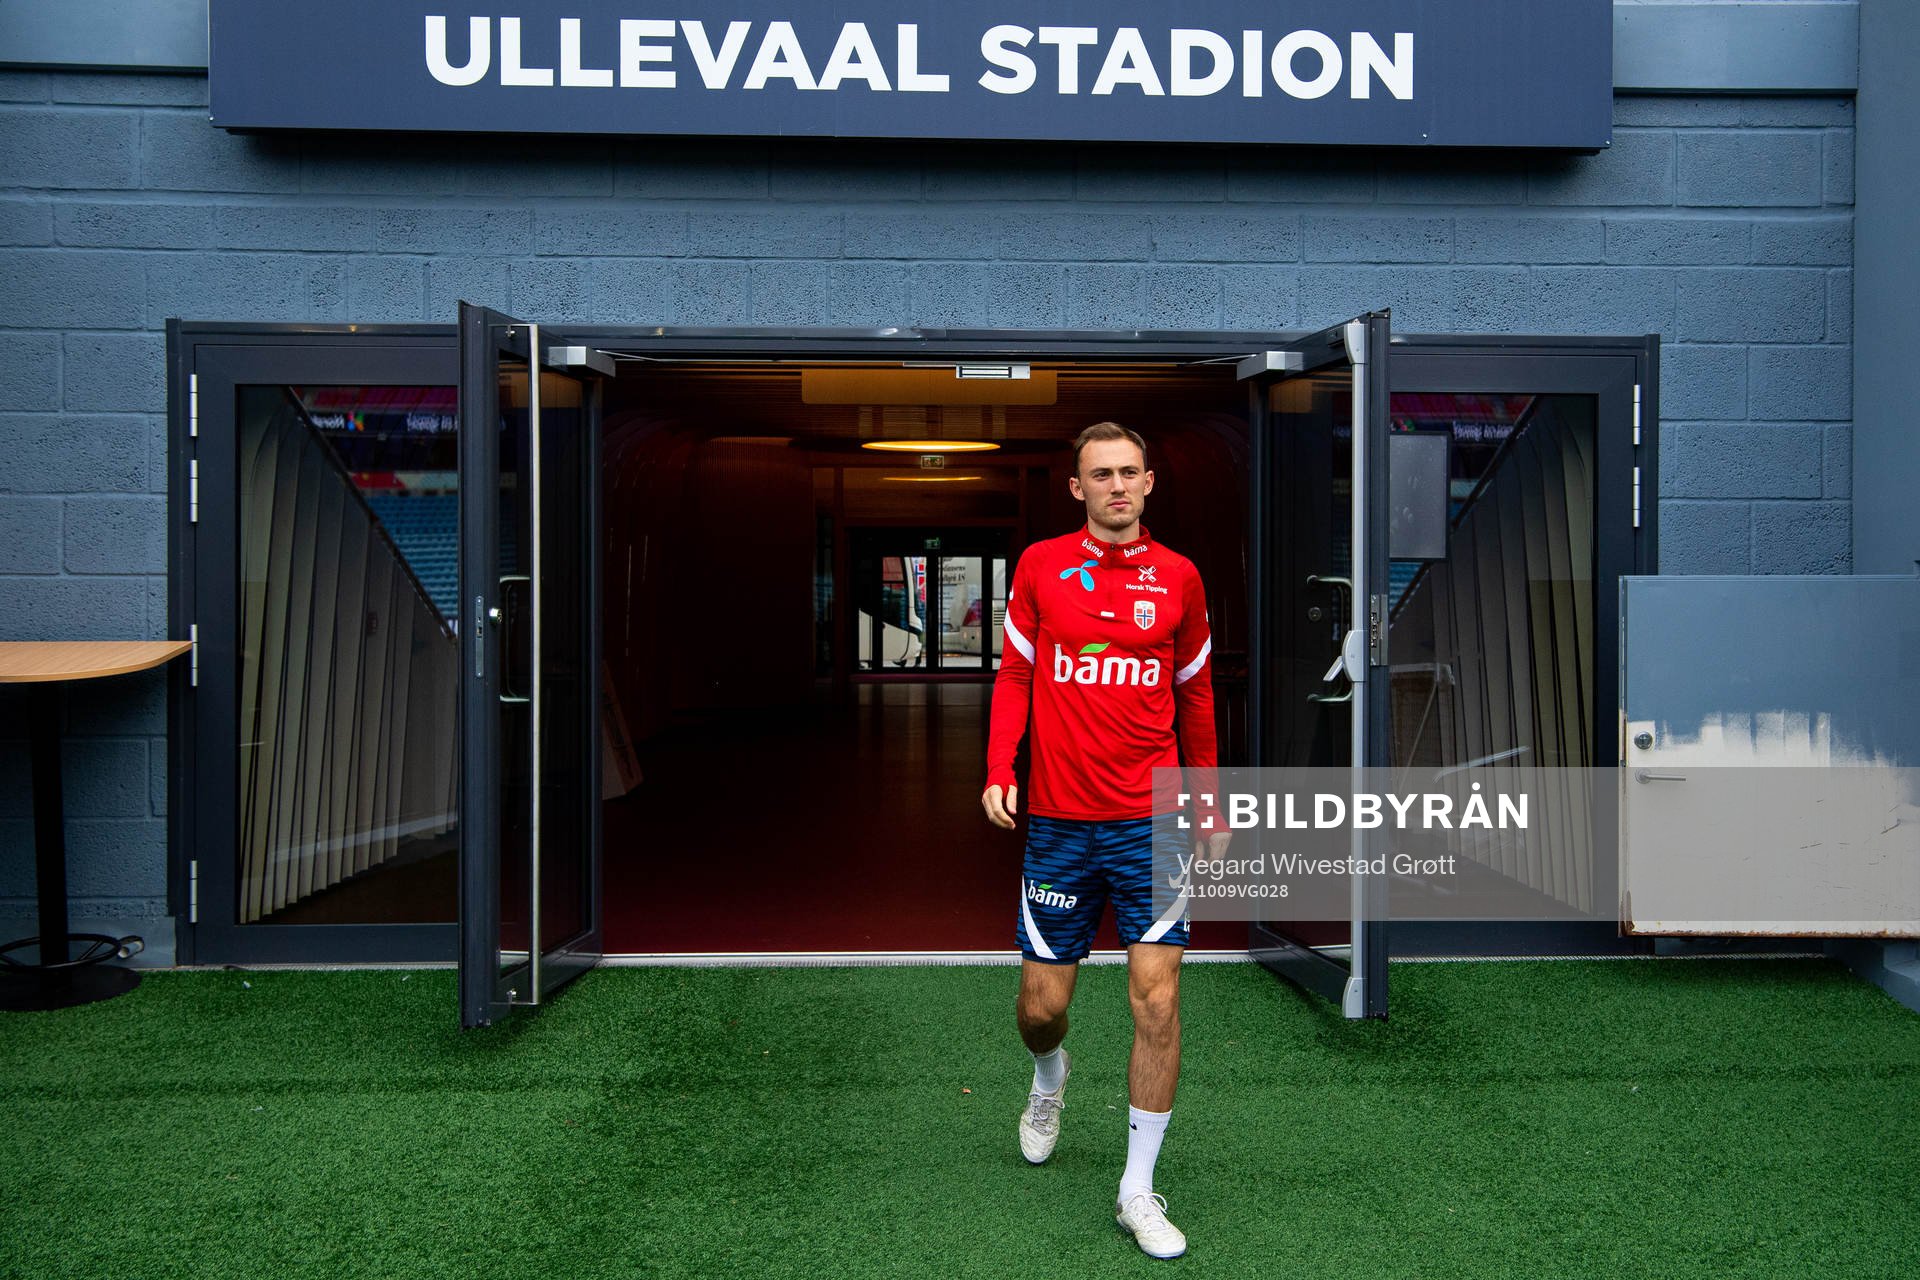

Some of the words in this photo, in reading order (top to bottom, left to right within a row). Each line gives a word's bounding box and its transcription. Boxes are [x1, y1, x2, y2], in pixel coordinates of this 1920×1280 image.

[425, 16, 950, 92] ULLEVAAL
[979, 25, 1414, 99] STADION
[1081, 538, 1105, 558] bama
[1124, 544, 1148, 558] bama
[1126, 583, 1145, 591] Norsk
[1145, 584, 1168, 595] Tipping
[1053, 643, 1161, 687] bama
[1027, 879, 1078, 910] bama
